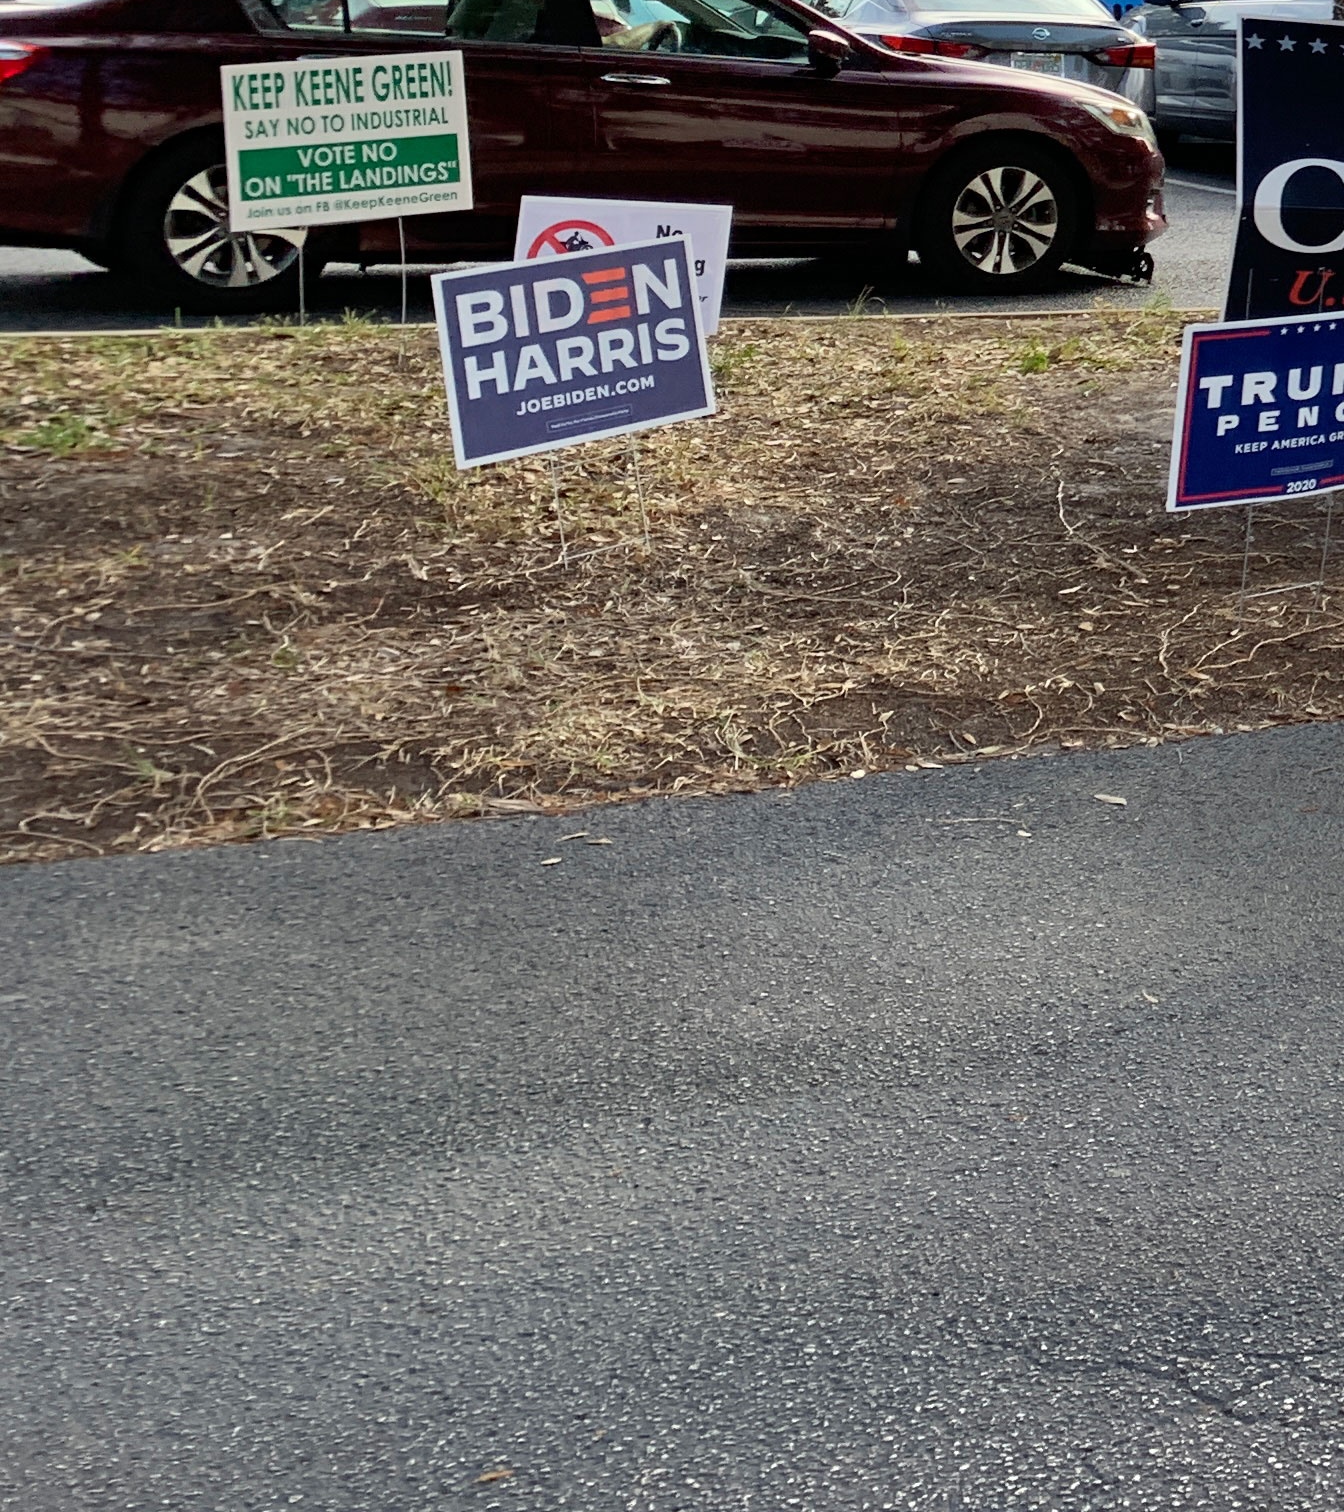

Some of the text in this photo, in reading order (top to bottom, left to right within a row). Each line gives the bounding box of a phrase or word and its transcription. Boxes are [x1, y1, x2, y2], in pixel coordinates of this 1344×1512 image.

[231, 61, 453, 111] KEEP KEENE GREEN!
[244, 107, 449, 139] SAY NO TO INDUSTRIAL
[297, 142, 397, 168] VOTE NO
[244, 160, 457, 198] ON "THE LANDINGS"
[247, 190, 458, 219] Join us on FB @KeepKeeneGreen
[455, 258, 683, 348] BIDEN
[463, 318, 690, 400] HARRIS
[516, 375, 655, 416] JOEBIDEN.COM
[1234, 440, 1268, 454] KEEP
[1271, 434, 1326, 451] AMERICA
[1286, 478, 1317, 493] 2020
